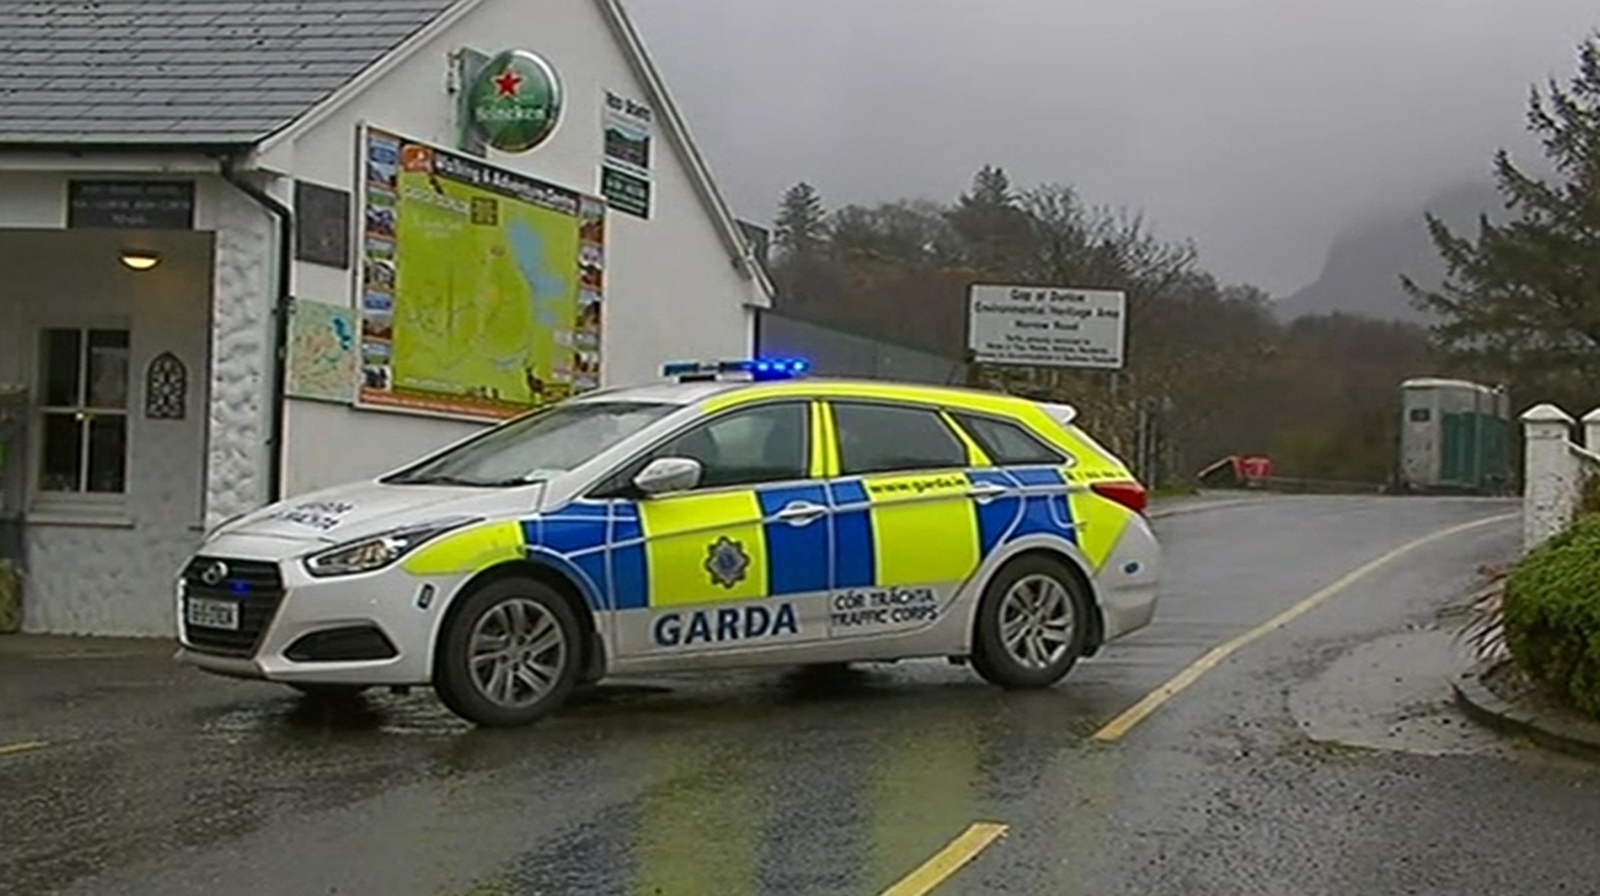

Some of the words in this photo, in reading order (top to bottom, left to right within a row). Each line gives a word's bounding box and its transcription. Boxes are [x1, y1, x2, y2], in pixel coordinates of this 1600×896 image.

[654, 602, 799, 648] GARDA
[830, 608, 888, 627] TRAFFIC
[890, 604, 939, 624] CORPS
